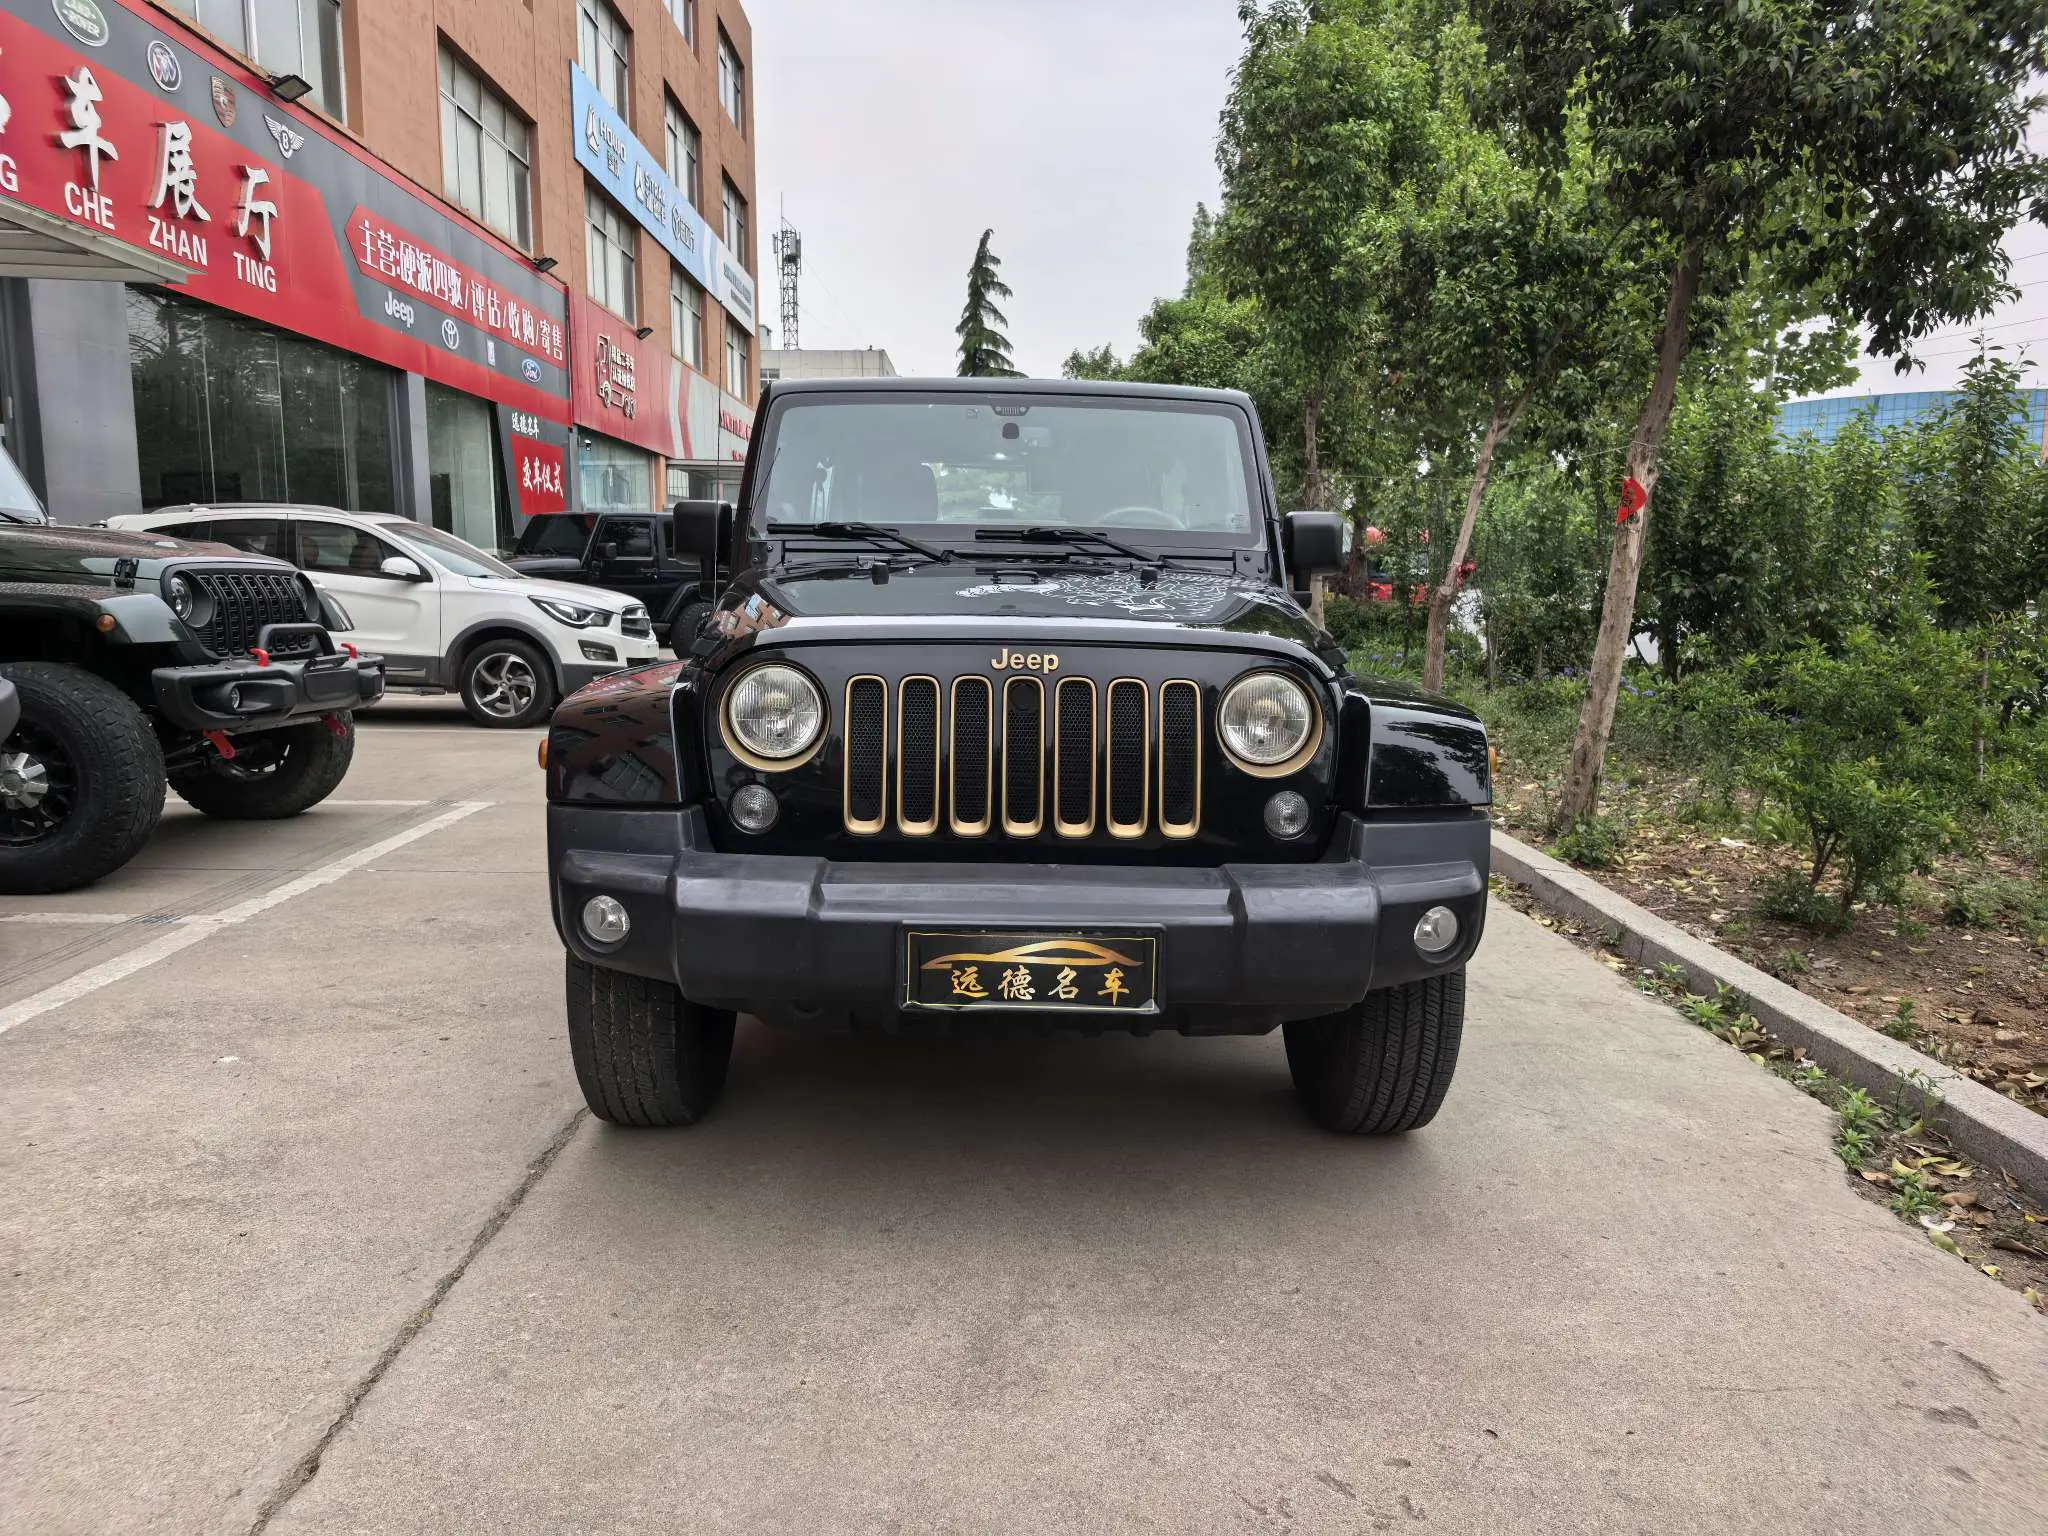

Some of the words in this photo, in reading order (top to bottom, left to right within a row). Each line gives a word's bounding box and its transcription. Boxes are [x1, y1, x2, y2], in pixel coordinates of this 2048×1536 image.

[0, 65, 278, 261] 车展厅
[64, 182, 116, 230] CHE
[148, 216, 208, 266] ZHAN
[232, 252, 277, 293] TING
[384, 290, 414, 328] Jeep
[522, 456, 564, 498] 交车仪式
[991, 648, 1059, 674] Jeep
[951, 965, 1129, 1006] 远德名车
